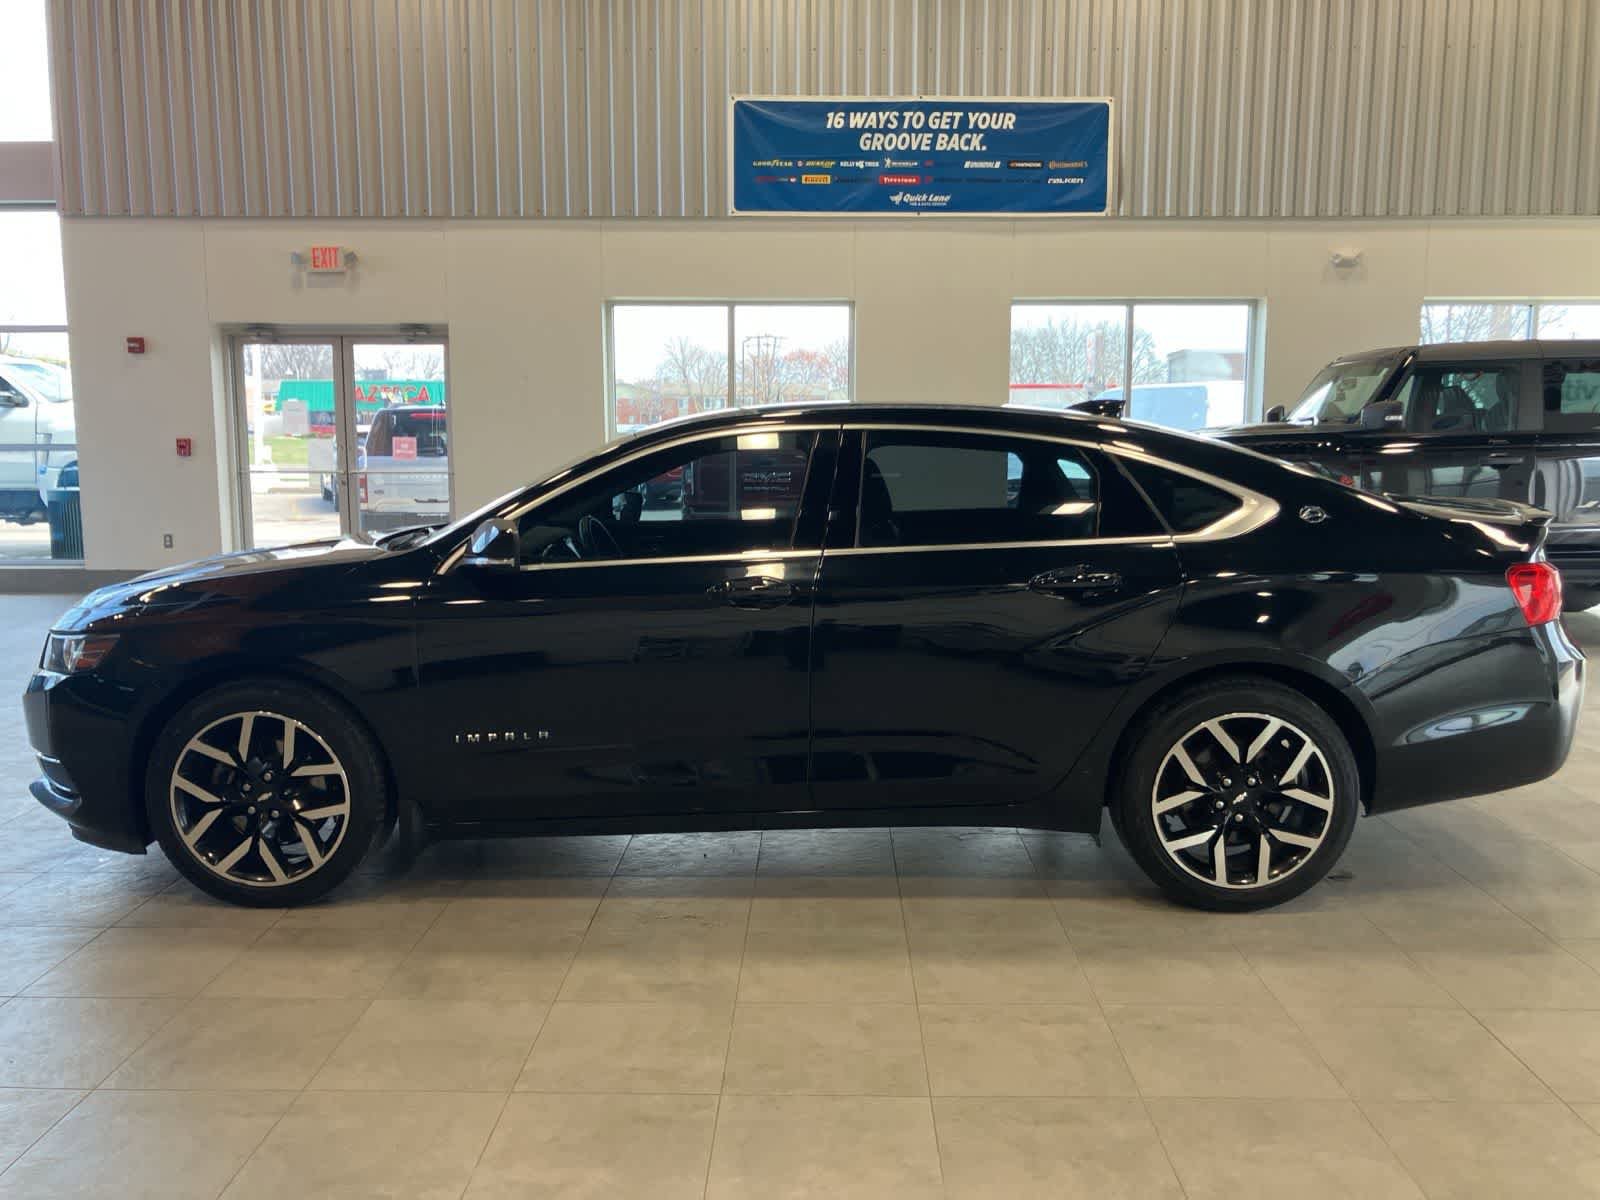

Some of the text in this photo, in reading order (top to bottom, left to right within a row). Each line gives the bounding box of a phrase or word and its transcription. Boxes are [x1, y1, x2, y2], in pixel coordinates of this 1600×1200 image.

[826, 111, 1017, 129] 16 WAYS TO GET YOUR
[859, 133, 988, 151] GROOVE BACK.
[903, 193, 952, 203] Quick Lane
[311, 246, 338, 269] EXIT
[454, 730, 550, 743] IMPALA
